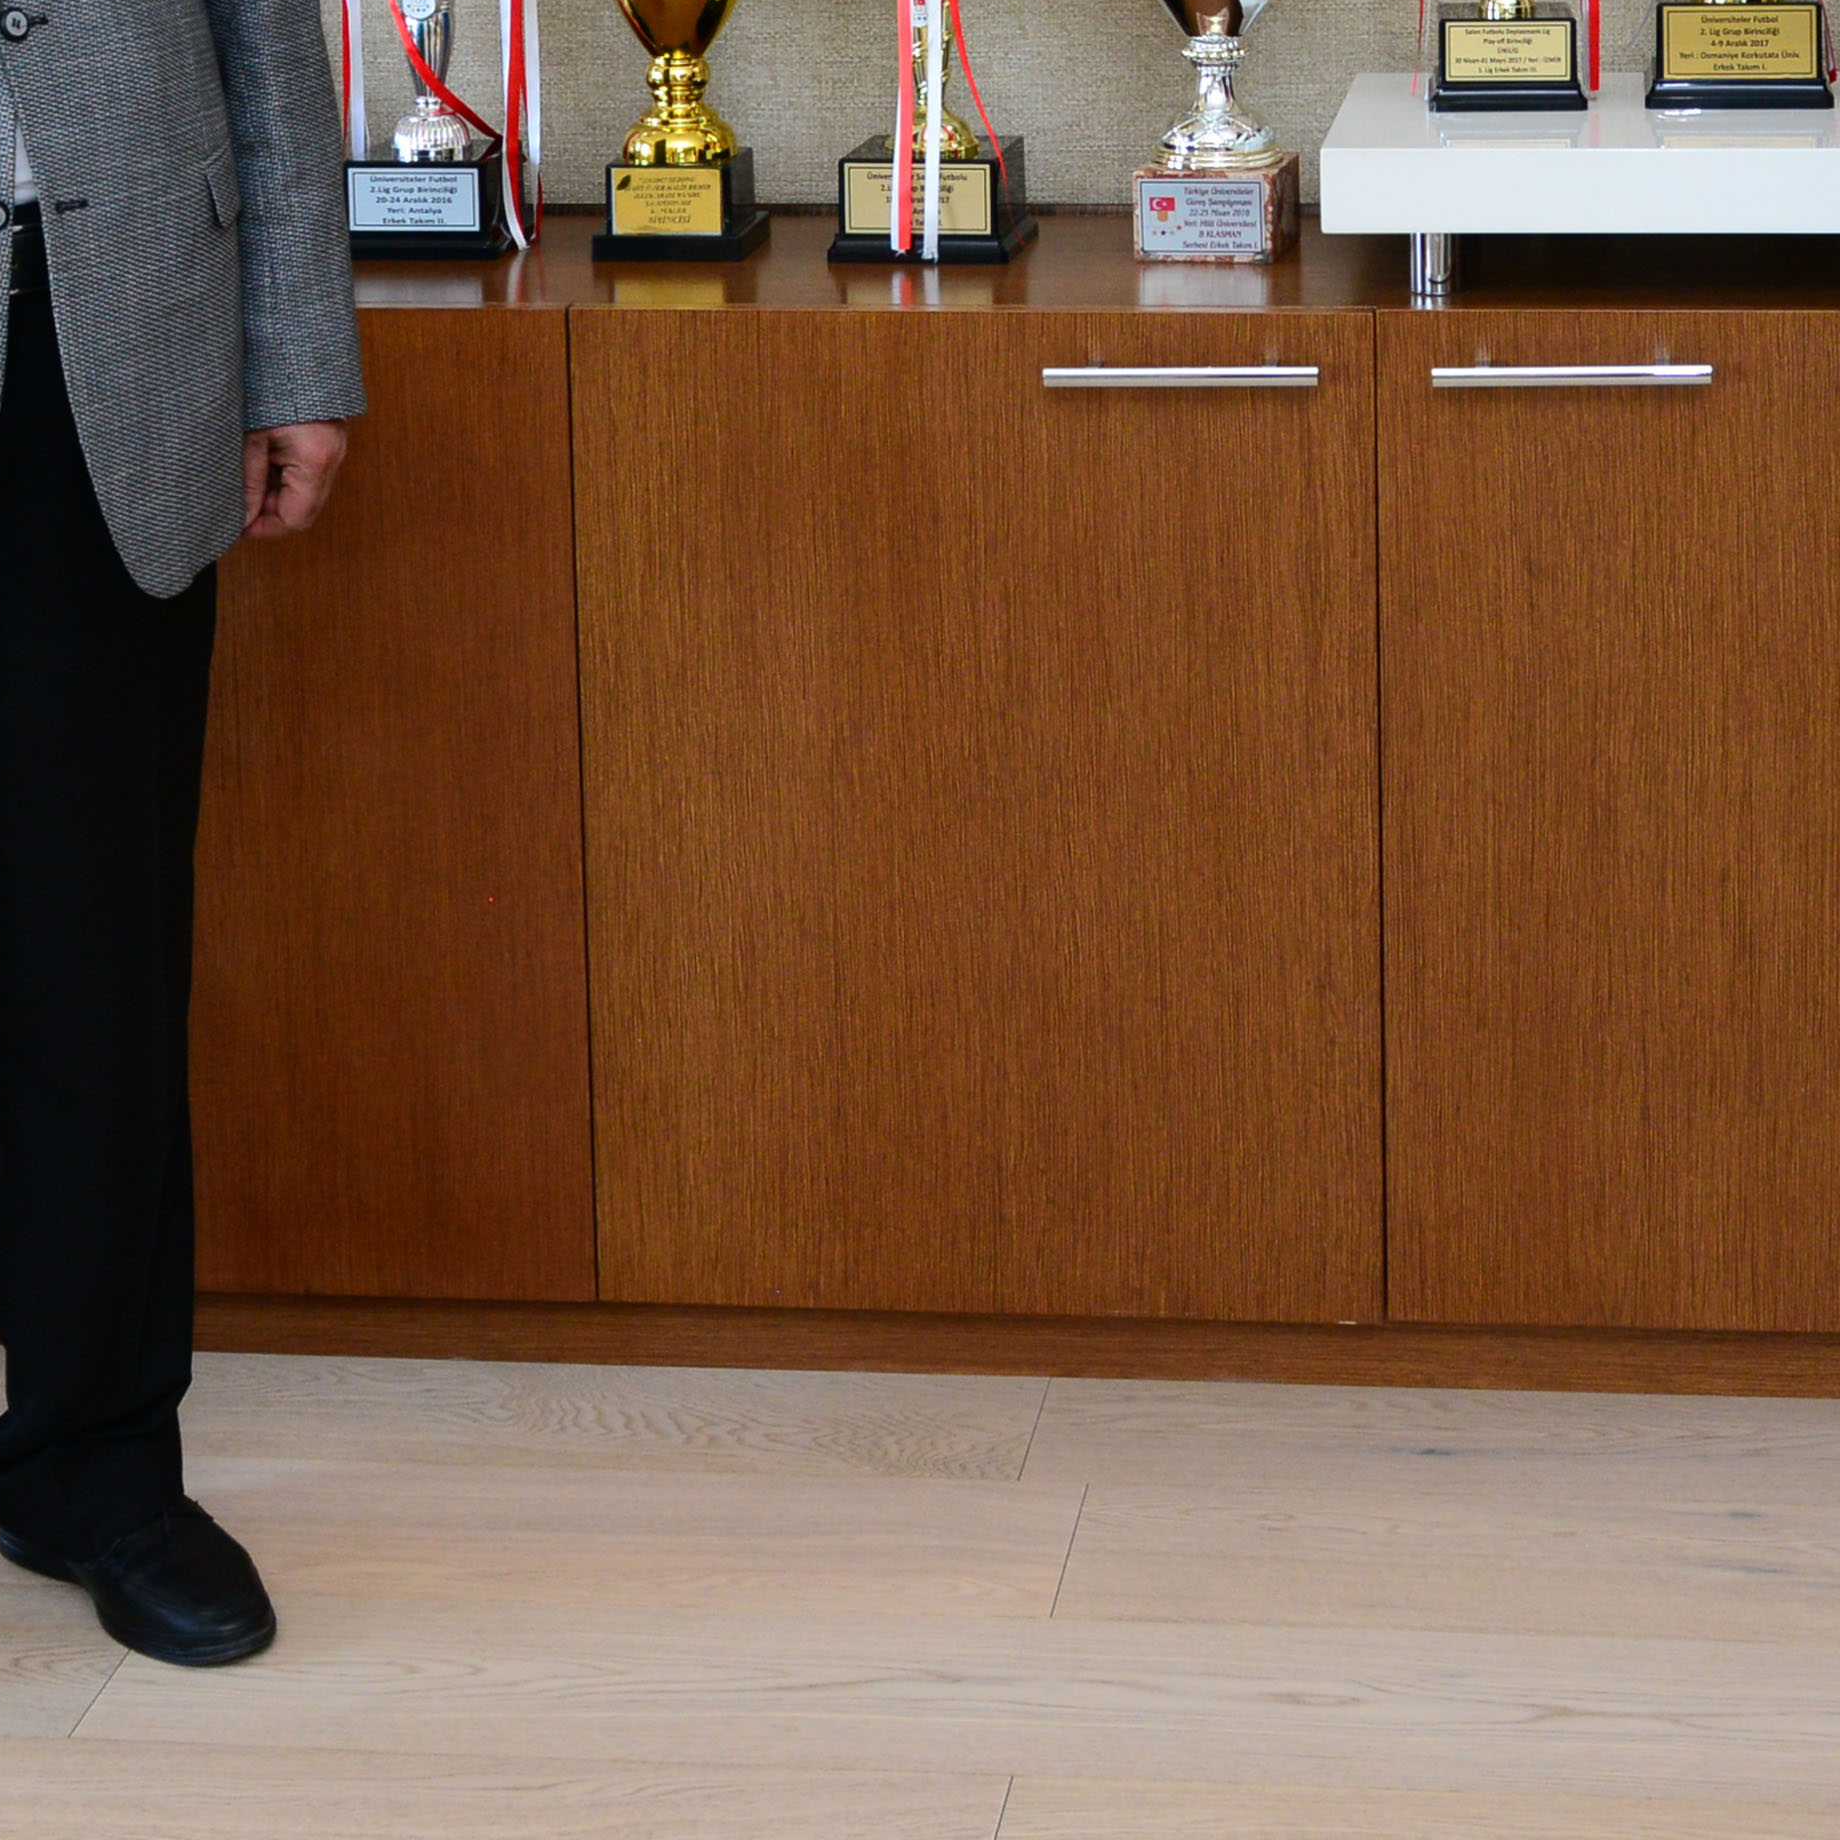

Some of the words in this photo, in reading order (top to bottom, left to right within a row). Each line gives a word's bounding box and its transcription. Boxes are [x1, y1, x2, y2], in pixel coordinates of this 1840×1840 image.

[1701, 15, 1751, 24] Üniversiteler
[1753, 15, 1778, 23] Futbol
[1723, 28, 1741, 37] Grup
[1700, 52, 1738, 60] Osmaniye
[1714, 63, 1735, 71] Erkek
[1737, 63, 1760, 71] Takım
[370, 175, 426, 183] Üniversiteler
[393, 186, 414, 194] Grup
[408, 207, 442, 215] Antalya
